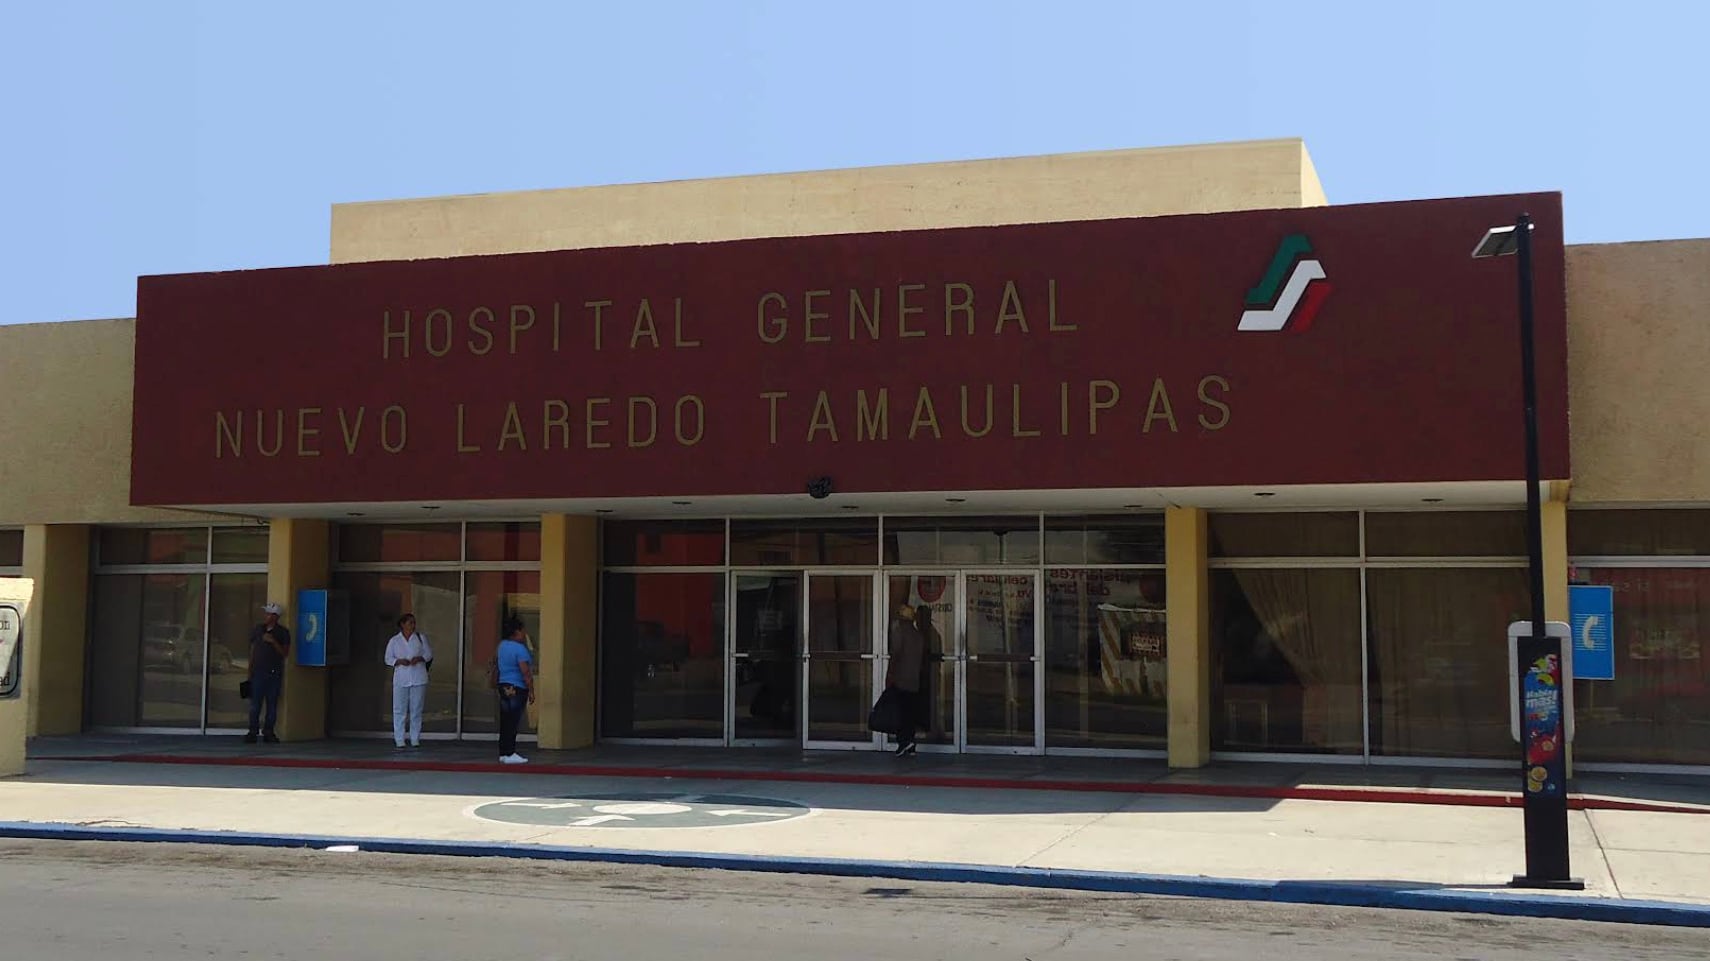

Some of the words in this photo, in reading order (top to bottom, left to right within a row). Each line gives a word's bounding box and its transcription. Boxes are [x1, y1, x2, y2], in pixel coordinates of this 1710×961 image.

[383, 298, 701, 359] HOSPITAL
[757, 279, 1078, 344] GENERAL
[215, 405, 408, 458] NUEVO
[456, 394, 706, 452] LAREDO
[759, 375, 1232, 444] TAMAULIPAS
